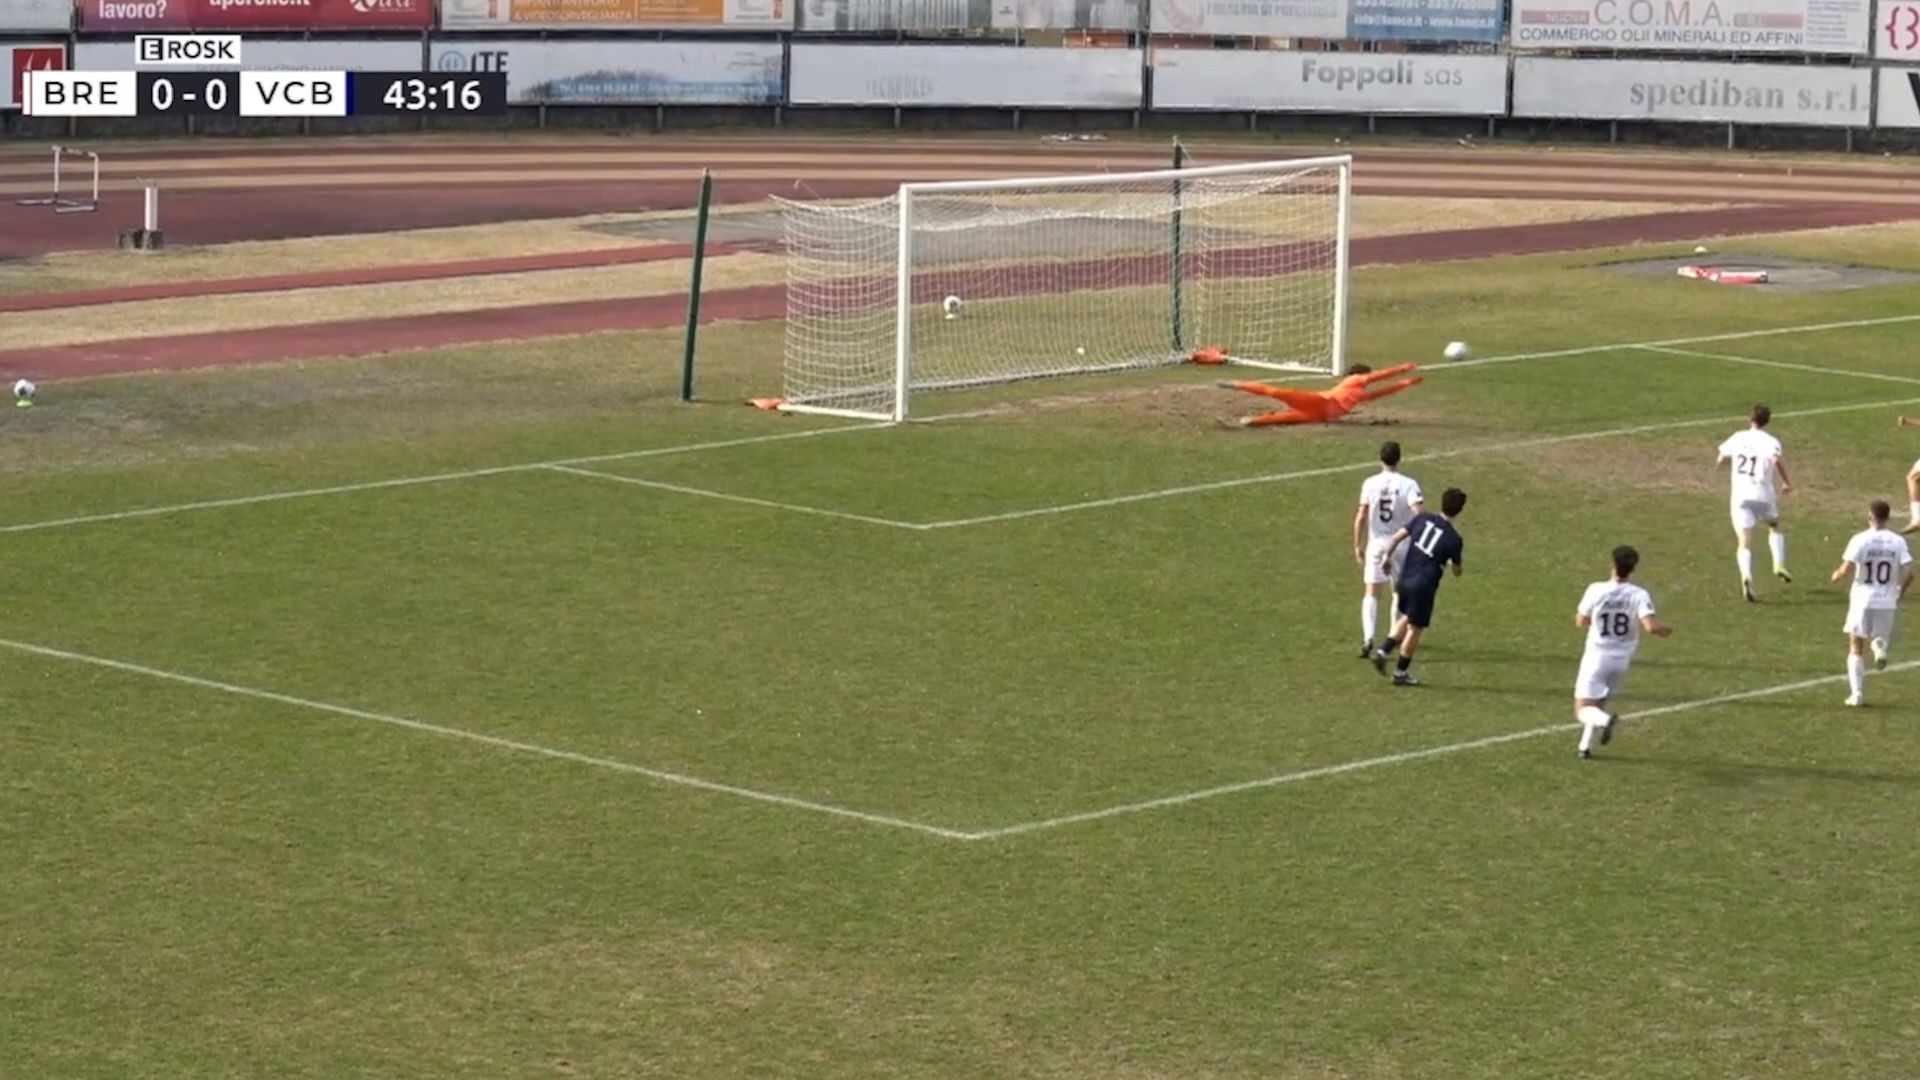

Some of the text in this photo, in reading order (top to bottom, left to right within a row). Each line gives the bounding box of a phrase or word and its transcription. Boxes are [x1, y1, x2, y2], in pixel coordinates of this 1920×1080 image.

[99, 0, 167, 18] lavoro?
[1520, 28, 1617, 41] COMMERCIO
[1654, 30, 1726, 43] MINERALI
[1730, 31, 1751, 43] ED
[1755, 32, 1804, 45] AFFINI
[1302, 60, 1463, 91] Foppoli sas
[1630, 77, 1784, 111] spediban
[1797, 82, 1869, 111] s.r.l.
[1737, 454, 1757, 476] 21
[1379, 499, 1392, 522] 5
[1414, 520, 1444, 557] 11
[1864, 561, 1891, 585] 10
[1600, 612, 1629, 636] 18
